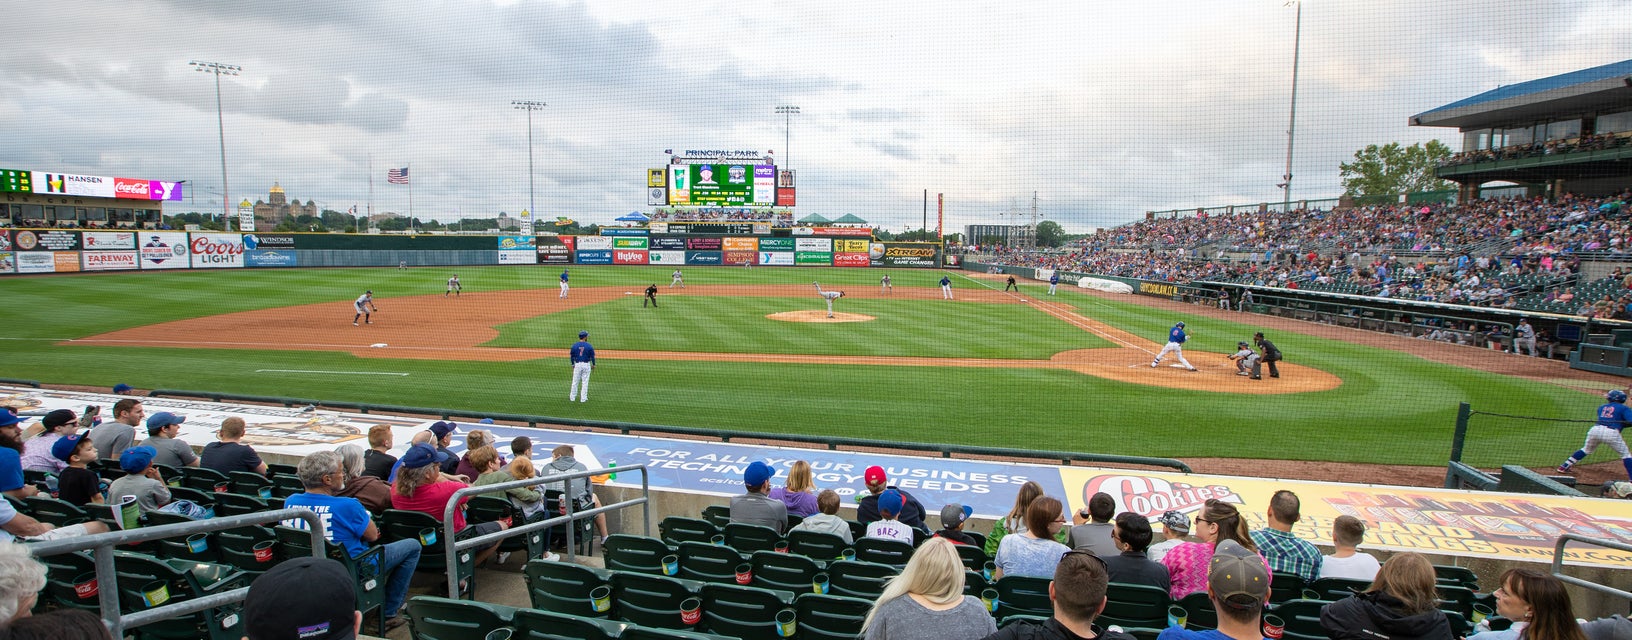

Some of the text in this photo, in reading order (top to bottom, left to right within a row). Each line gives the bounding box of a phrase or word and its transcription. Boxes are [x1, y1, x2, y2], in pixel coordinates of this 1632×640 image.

[685, 149, 759, 157] PRINCIPAL PARK
[68, 176, 103, 184] HANSEN
[115, 181, 150, 195] Coca-Cola
[191, 236, 243, 255] Coors
[852, 254, 868, 262] Clips
[887, 248, 935, 257] XTREAM
[202, 255, 235, 263] LIGHT
[1600, 406, 1615, 418] 12
[627, 447, 692, 459] FOR
[695, 453, 751, 464] ALL
[864, 465, 1029, 485] USINESS
[647, 458, 864, 483] TECHNLGY
[1087, 475, 1231, 517] Cookies
[313, 505, 330, 513] THE
[877, 527, 899, 538] BAEZ
